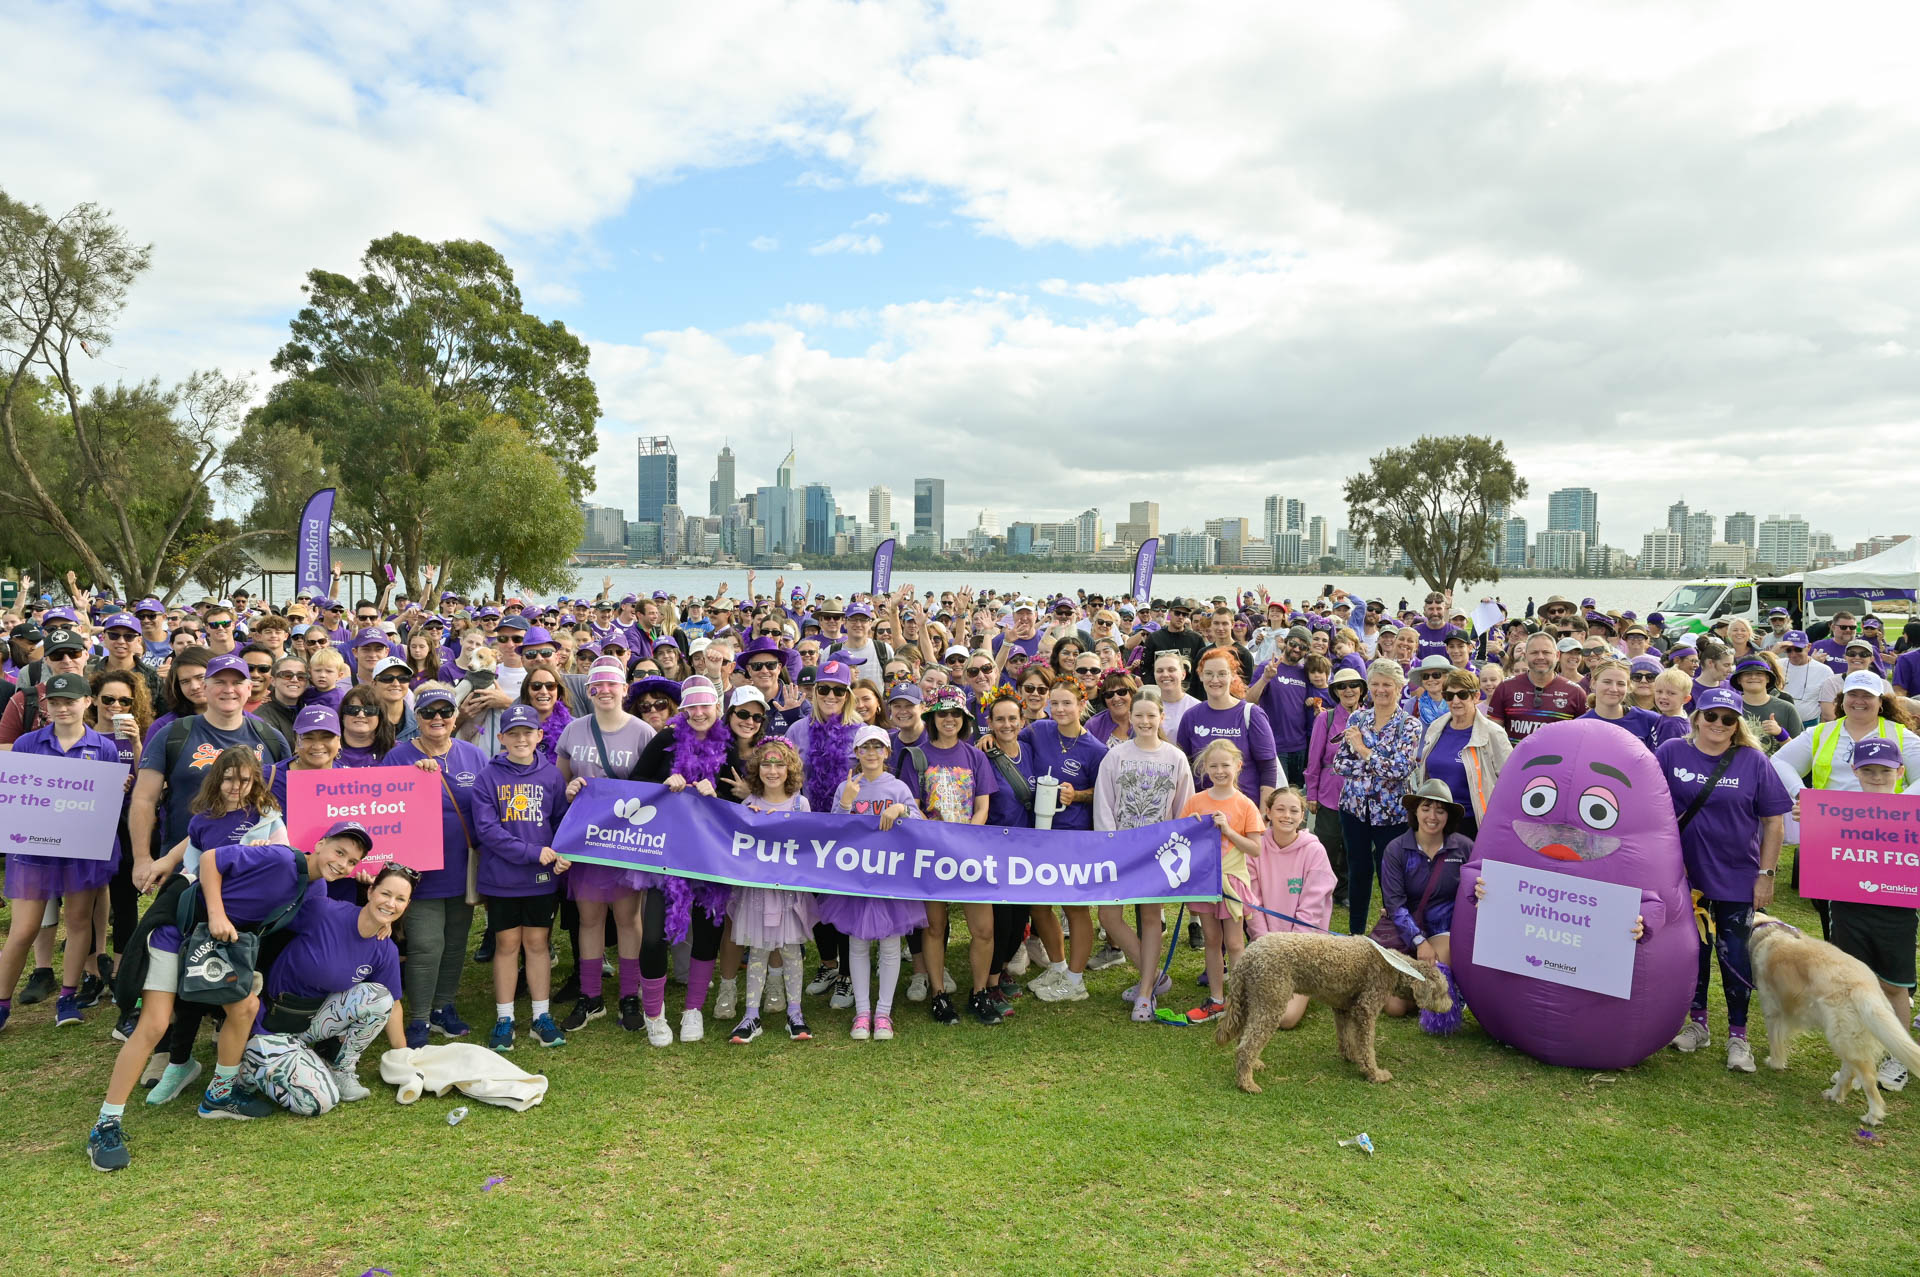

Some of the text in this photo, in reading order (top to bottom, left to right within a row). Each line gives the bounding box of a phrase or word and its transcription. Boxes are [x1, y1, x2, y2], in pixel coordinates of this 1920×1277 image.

[305, 519, 319, 582] Pankind
[877, 555, 886, 588] Pankind
[1139, 553, 1149, 586] Pankind
[1211, 727, 1241, 735] Pankind
[0, 771, 94, 792] Let's stroll
[316, 781, 415, 798] Putting our
[497, 783, 544, 801] LOS ANGELES
[20, 794, 51, 807] the
[54, 799, 96, 812] goal
[327, 800, 406, 817] best foot
[1817, 803, 1911, 821] Together
[29, 835, 61, 844] Pankind
[585, 823, 666, 848] Pankind
[1840, 828, 1919, 844] make it
[585, 840, 663, 856] Pancreatic Cancer Australia
[1831, 846, 1879, 864] FAIR
[731, 830, 1118, 886] Put Your Foot Down
[1518, 879, 1598, 907] Progress
[1880, 883, 1918, 893] Pankind
[1520, 903, 1591, 928] without
[1524, 924, 1583, 948] PAUSE
[1544, 959, 1577, 973] Pankind
